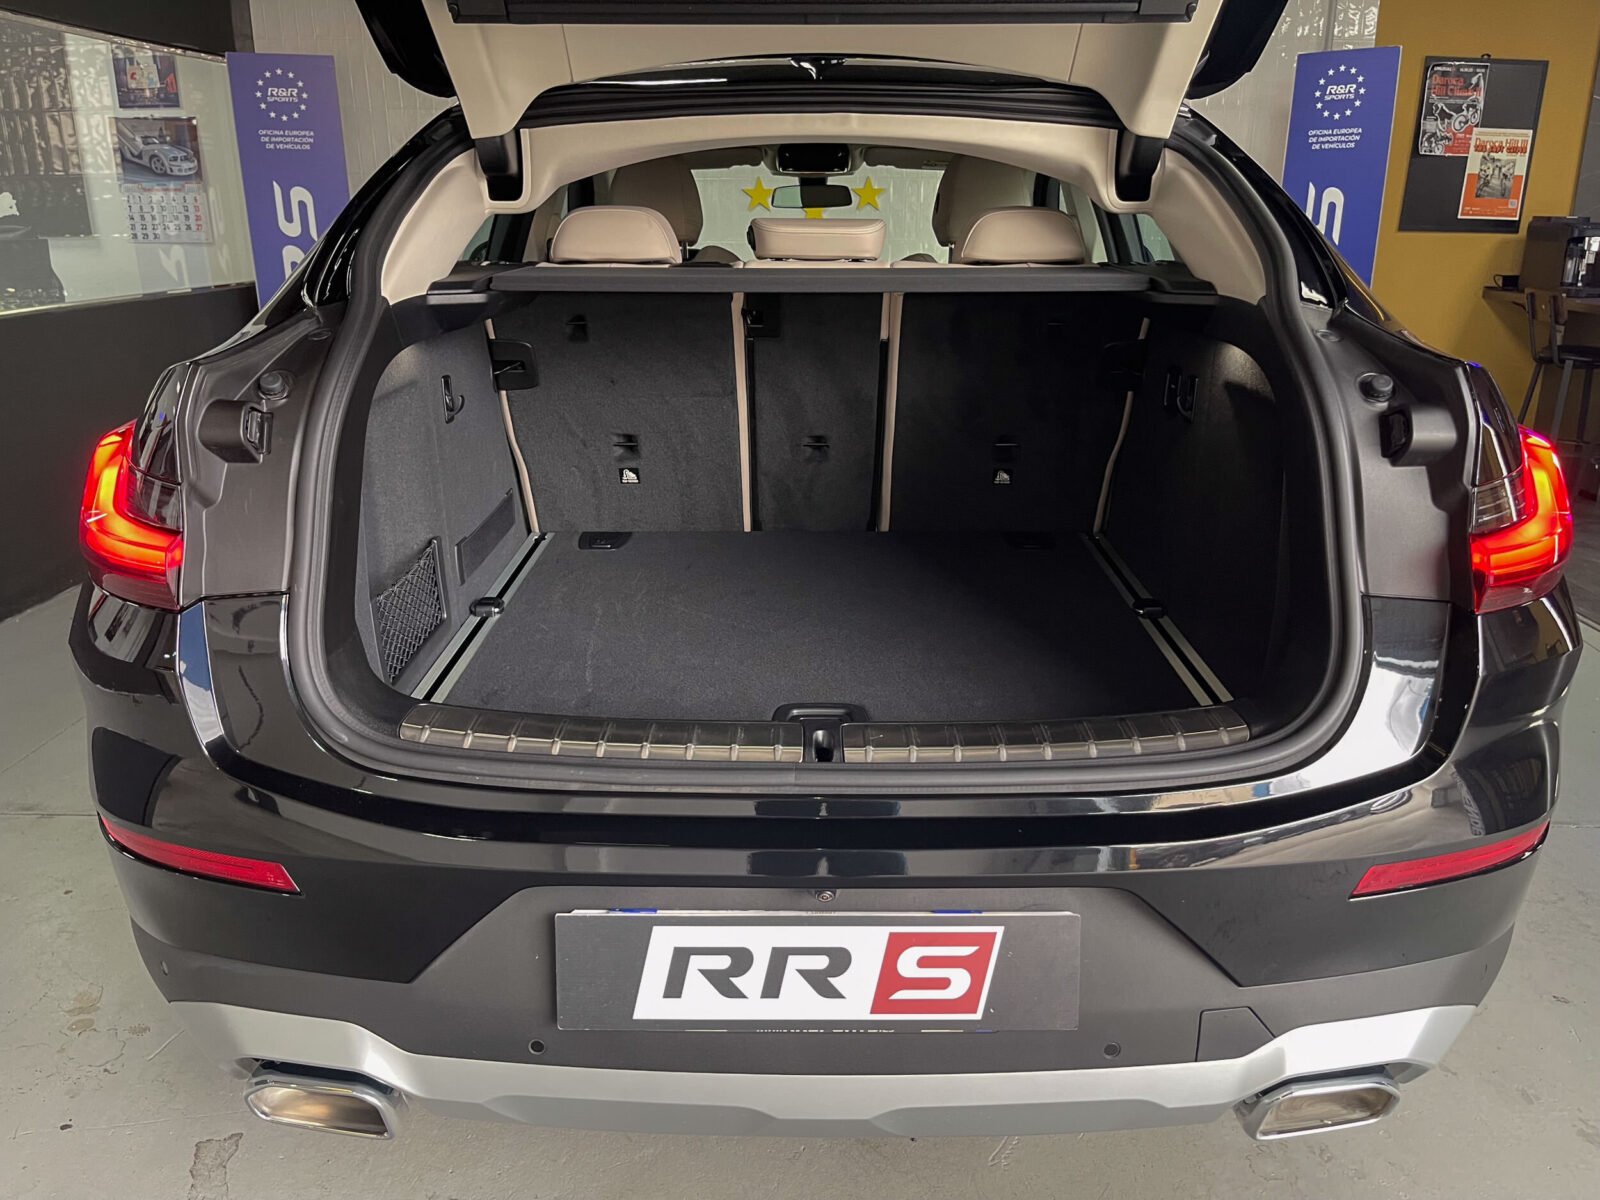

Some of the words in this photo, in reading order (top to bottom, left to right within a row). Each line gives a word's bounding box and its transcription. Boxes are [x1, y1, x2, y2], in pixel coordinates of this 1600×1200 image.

[267, 87, 298, 97] R&R
[1326, 84, 1357, 95] R&R
[1324, 93, 1355, 101] SPORTS
[1333, 127, 1362, 135] EUROPEA
[1318, 134, 1361, 142] IMPORTACIÓN
[662, 946, 980, 1000] RRS
